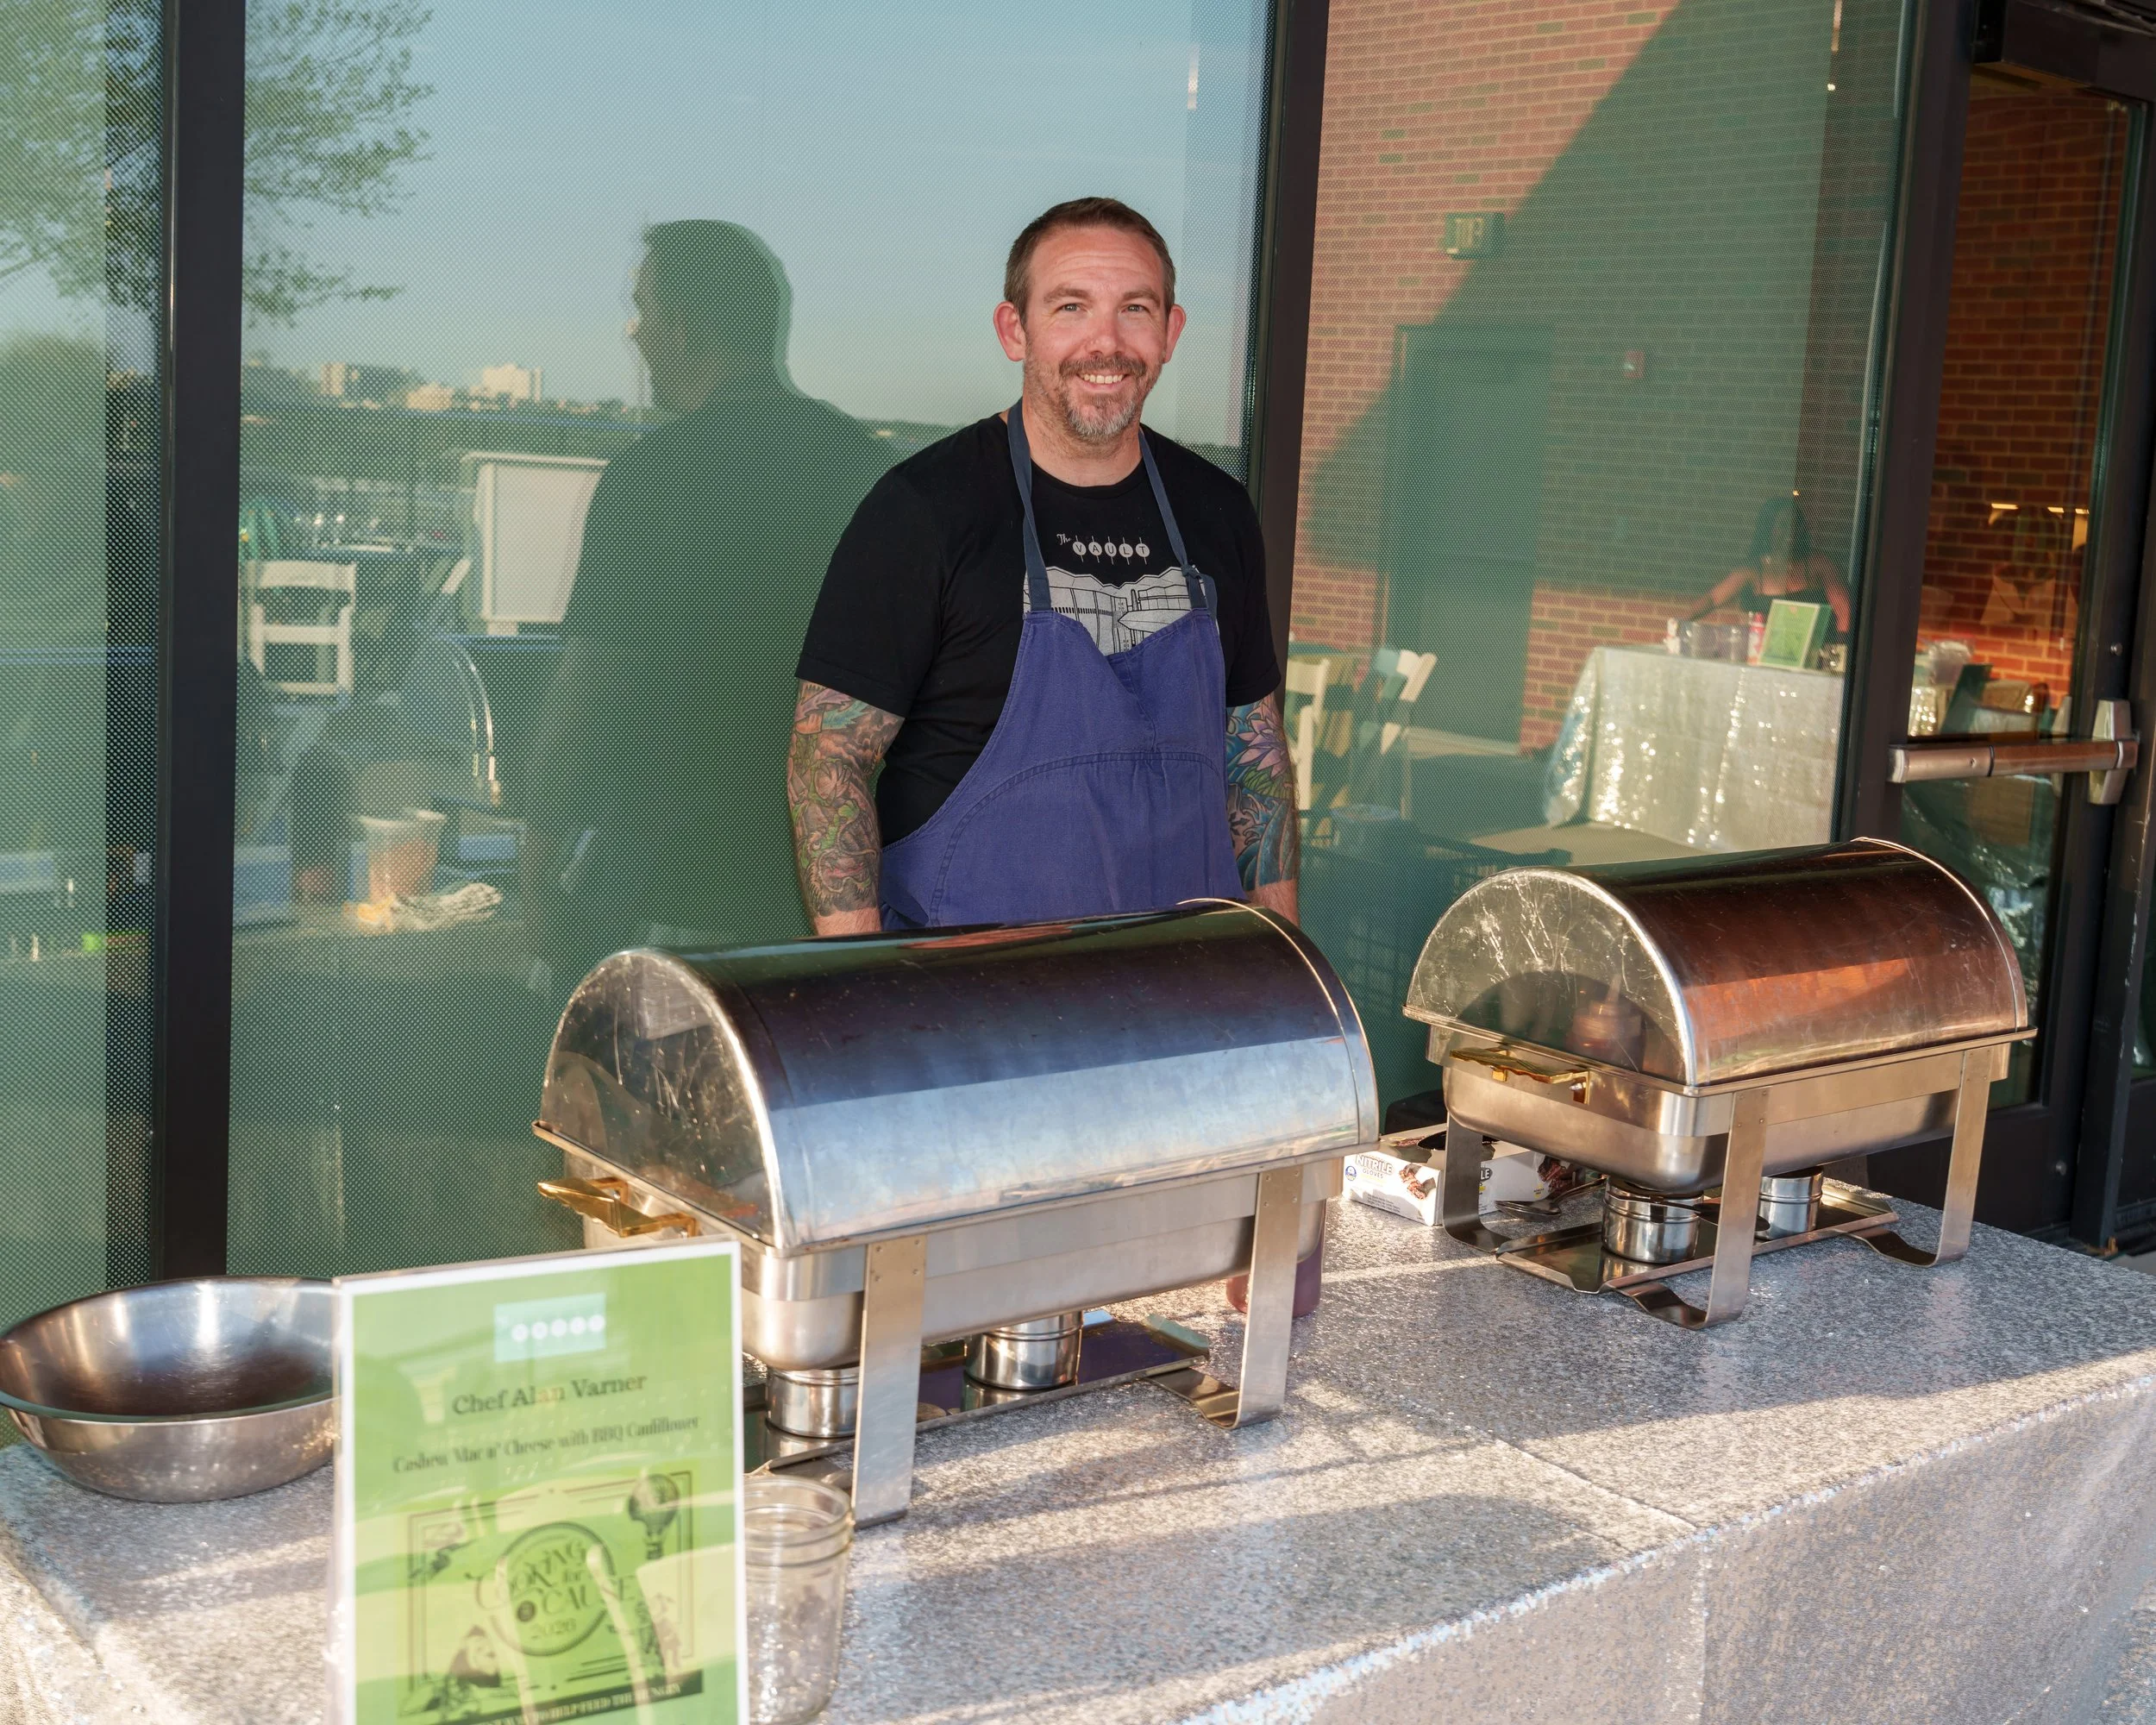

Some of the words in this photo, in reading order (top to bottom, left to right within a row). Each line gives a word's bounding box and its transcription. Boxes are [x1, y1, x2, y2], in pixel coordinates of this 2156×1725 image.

[1056, 533, 1072, 545] The
[1075, 543, 1148, 557] VAULT
[1355, 1154, 1394, 1175] NITRILE
[1363, 1168, 1384, 1180] GLOVES
[452, 1388, 509, 1416] Chef
[511, 1383, 566, 1408] Alan
[570, 1375, 648, 1400] Varner
[392, 1451, 448, 1473] Cashew
[453, 1445, 484, 1464] Mac
[504, 1436, 555, 1457] Cheese
[558, 1428, 589, 1448] with
[592, 1424, 624, 1445] BBQ
[626, 1414, 700, 1439] Cauliflower
